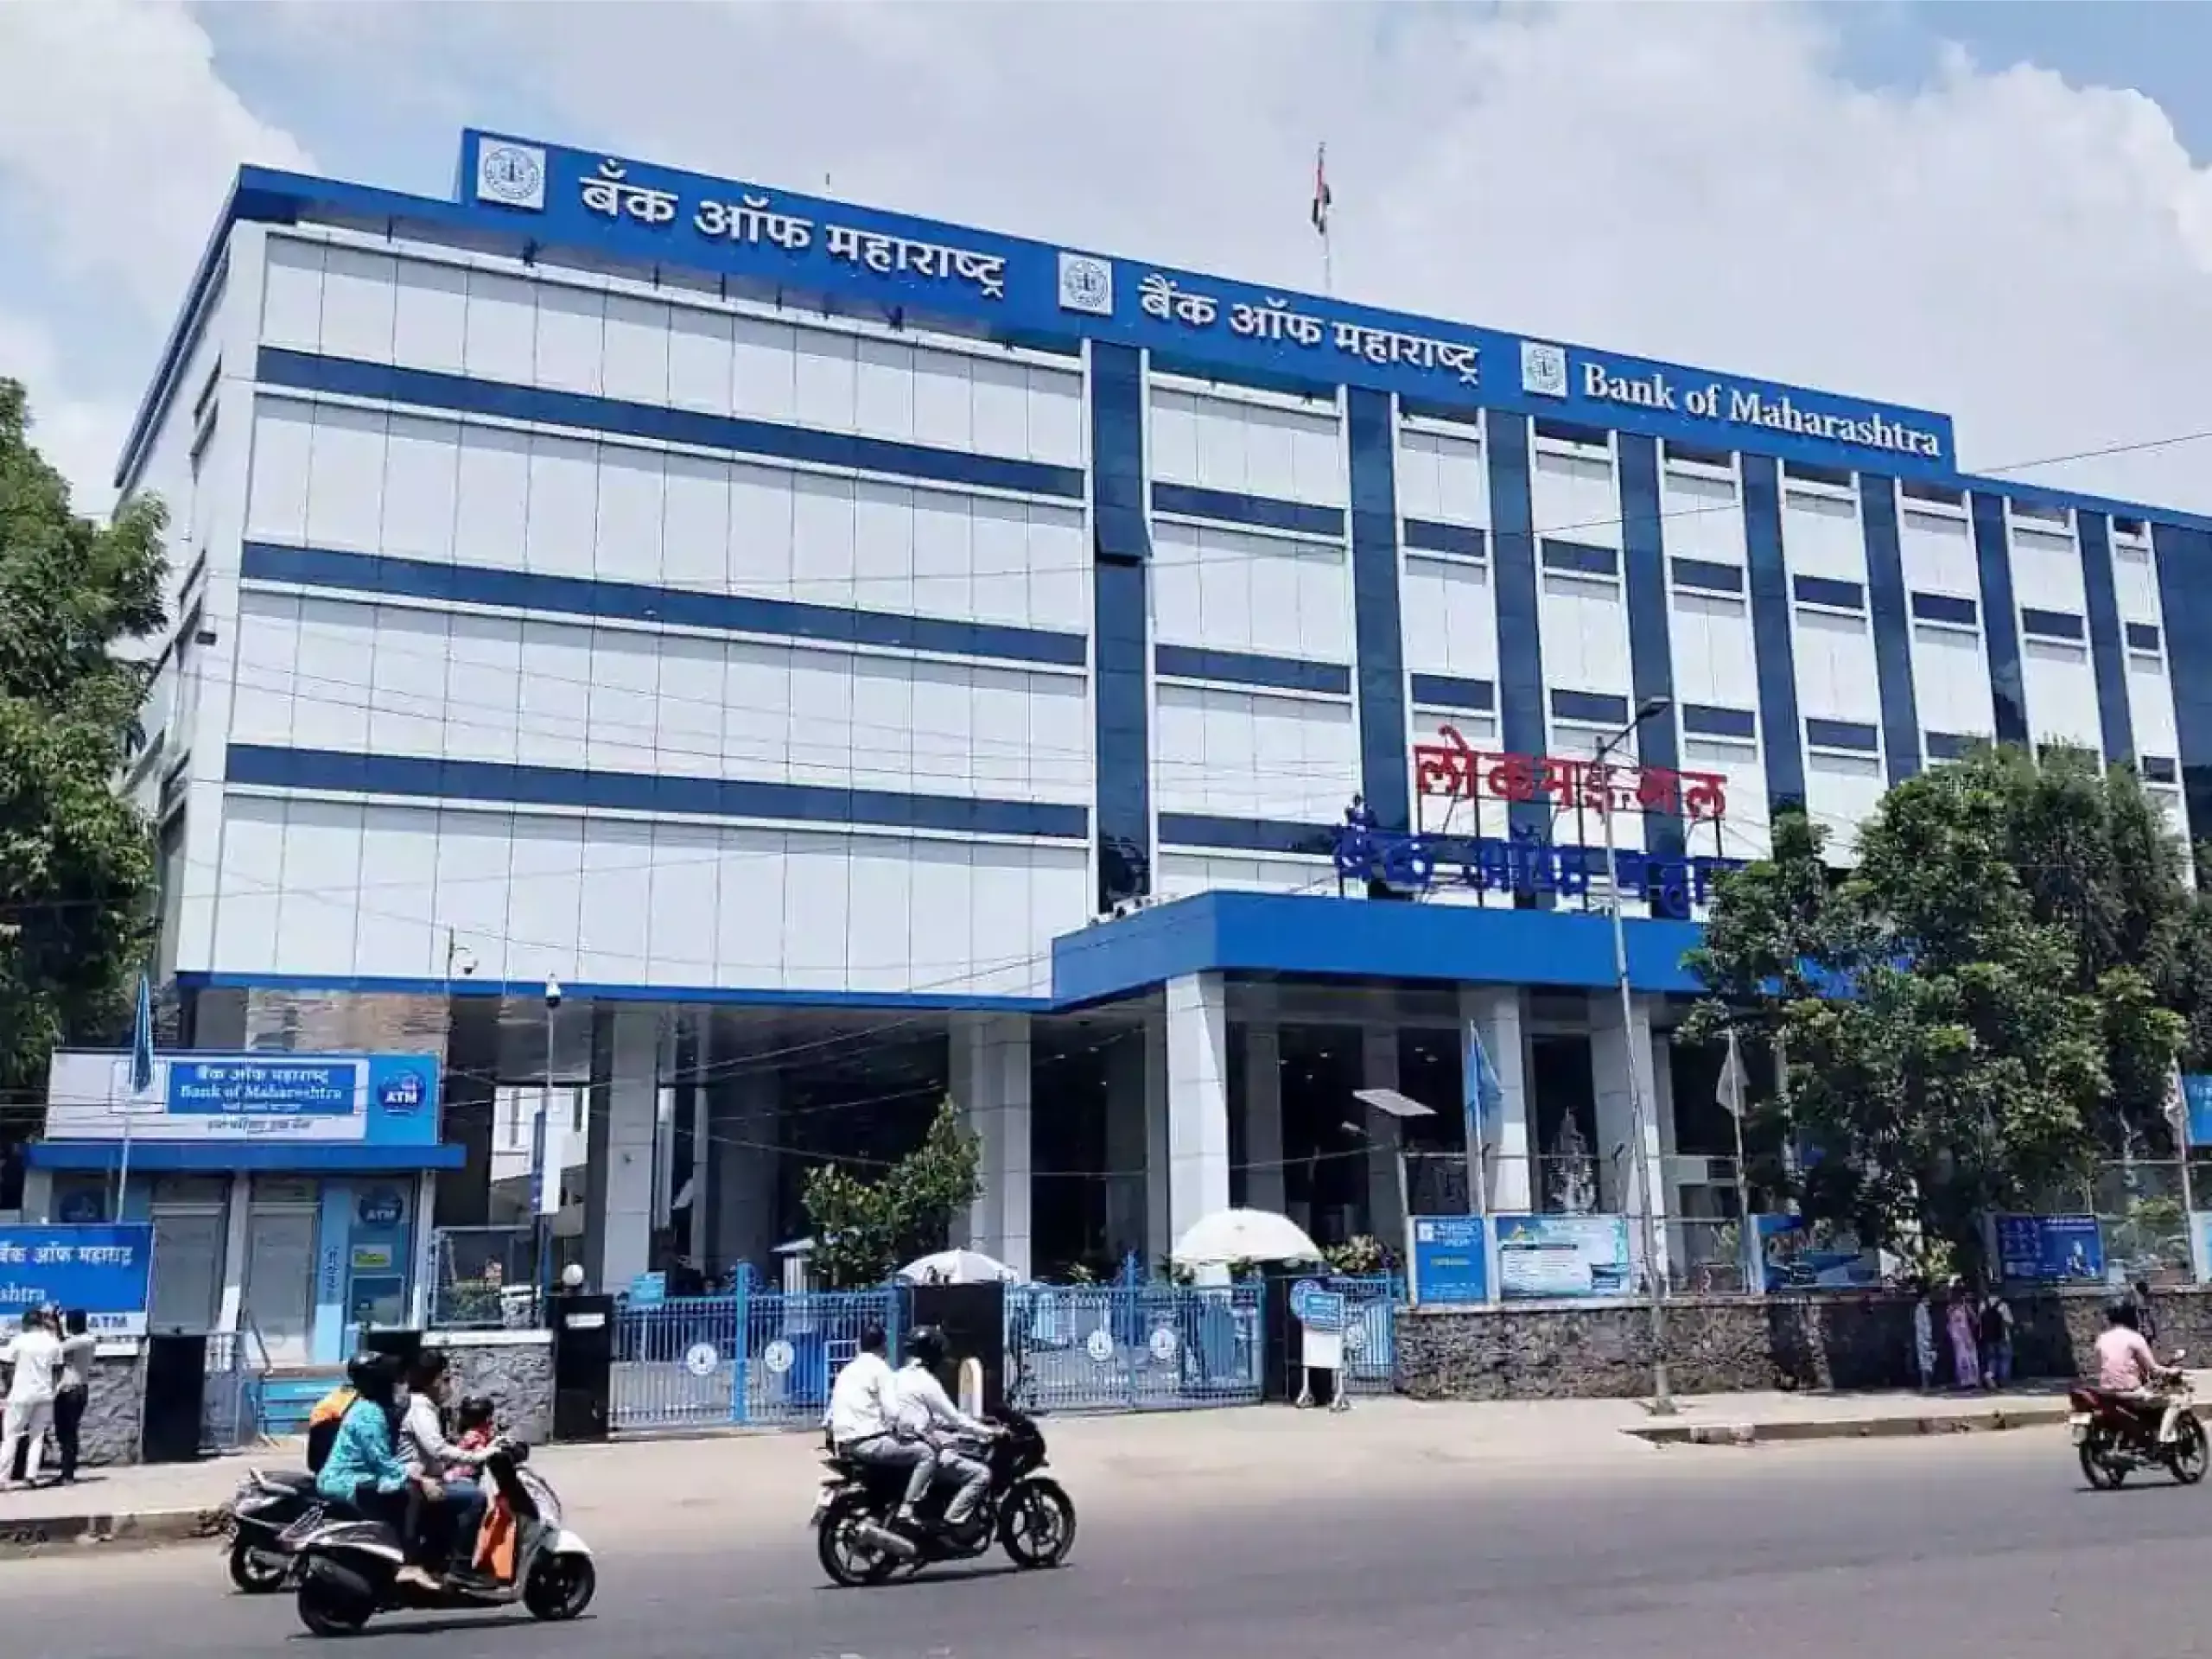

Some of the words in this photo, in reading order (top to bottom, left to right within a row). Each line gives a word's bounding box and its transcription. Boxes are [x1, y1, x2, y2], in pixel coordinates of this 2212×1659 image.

[579, 159, 679, 222] बँक
[694, 193, 815, 249] ऑफ
[825, 224, 1007, 299] महाराष्ट्र
[1137, 273, 1219, 325] बैंक
[1229, 296, 1325, 346] ऑफ
[1332, 322, 1480, 385] महाराष्ट्र
[1580, 362, 1676, 410] Bank
[1685, 384, 1723, 417] of
[1730, 388, 1942, 457] Maharashtra
[385, 1090, 417, 1103] ATM
[87, 1314, 129, 1329] ATM
